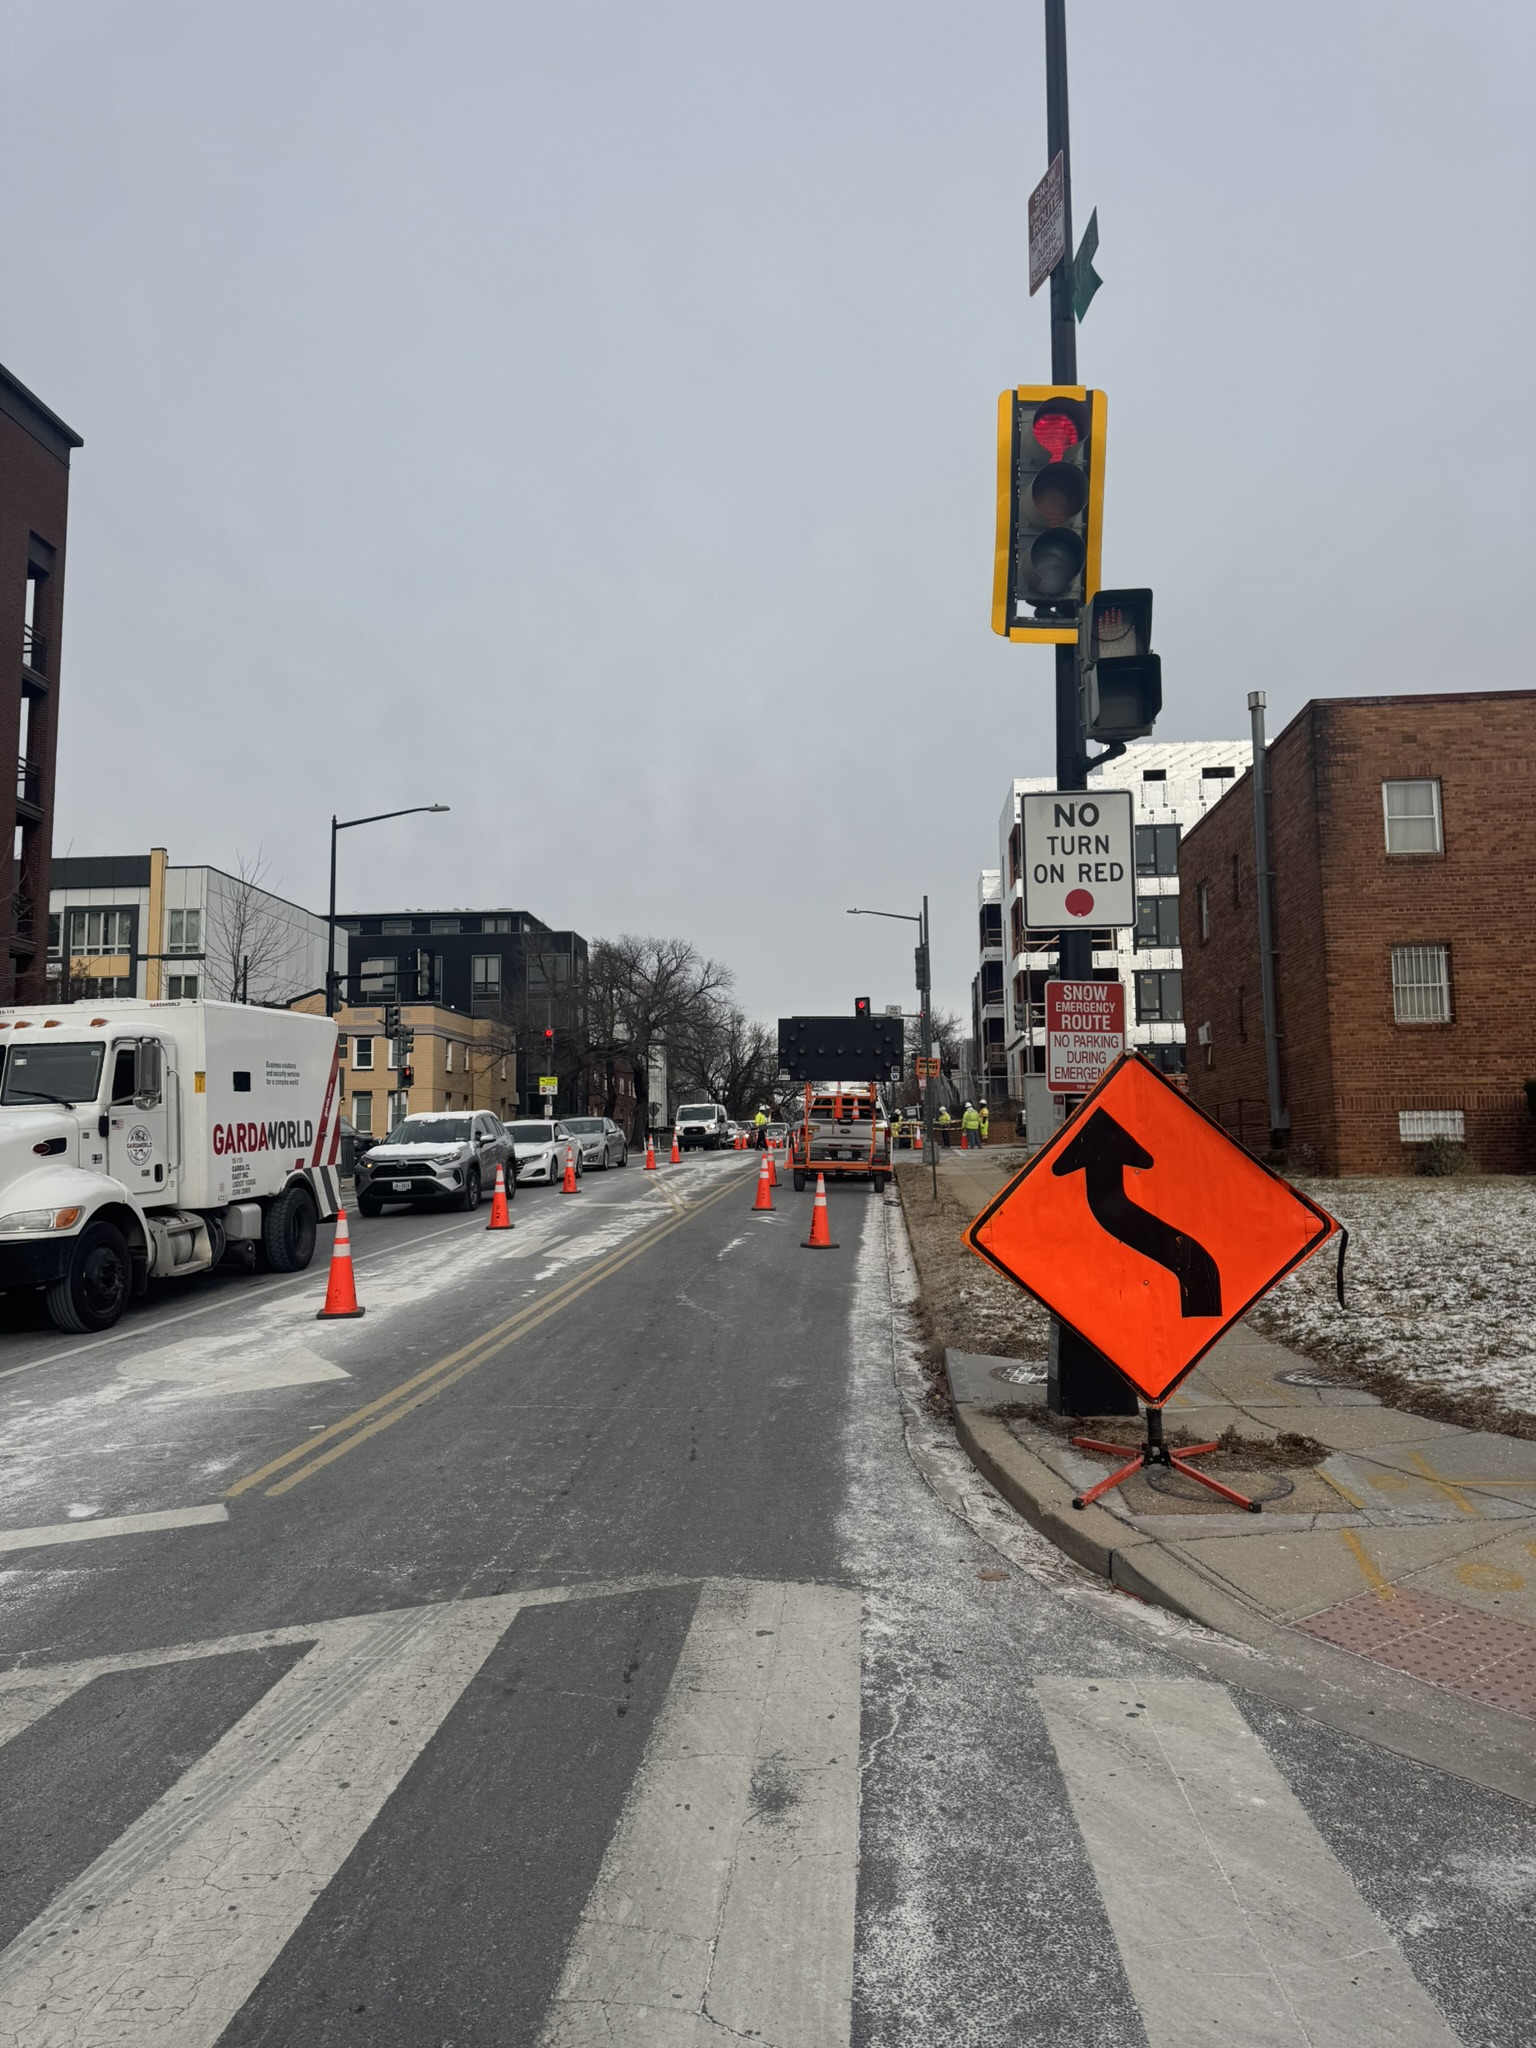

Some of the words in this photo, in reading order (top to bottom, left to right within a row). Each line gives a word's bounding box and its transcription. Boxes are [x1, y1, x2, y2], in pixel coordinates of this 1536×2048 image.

[1035, 165, 1057, 206] SNOW
[1031, 175, 1060, 224] EMERGENCY
[1032, 192, 1060, 237] ROUTE
[1040, 205, 1062, 240] PARKING
[1037, 229, 1057, 262] DURING
[1031, 235, 1062, 283] EMERGENCY
[1054, 802, 1100, 828] NO
[1047, 835, 1110, 856] TURN
[1033, 863, 1065, 884] ON
[1078, 862, 1124, 883] RED
[1063, 985, 1108, 1001] SNOW
[1055, 1002, 1116, 1013] EMERGENCY
[1061, 1014, 1111, 1030] ROUTE
[1054, 1034, 1070, 1047] NO
[1073, 1035, 1119, 1048] PARKING
[266, 1060, 281, 1068] Business
[1067, 1051, 1107, 1064] DURING
[273, 1070, 286, 1078] security
[1054, 1066, 1105, 1080] EMERGEN
[213, 1119, 313, 1156] GARDAWORLD
[231, 1164, 245, 1172] GARDA
[232, 1172, 242, 1180] EAST
